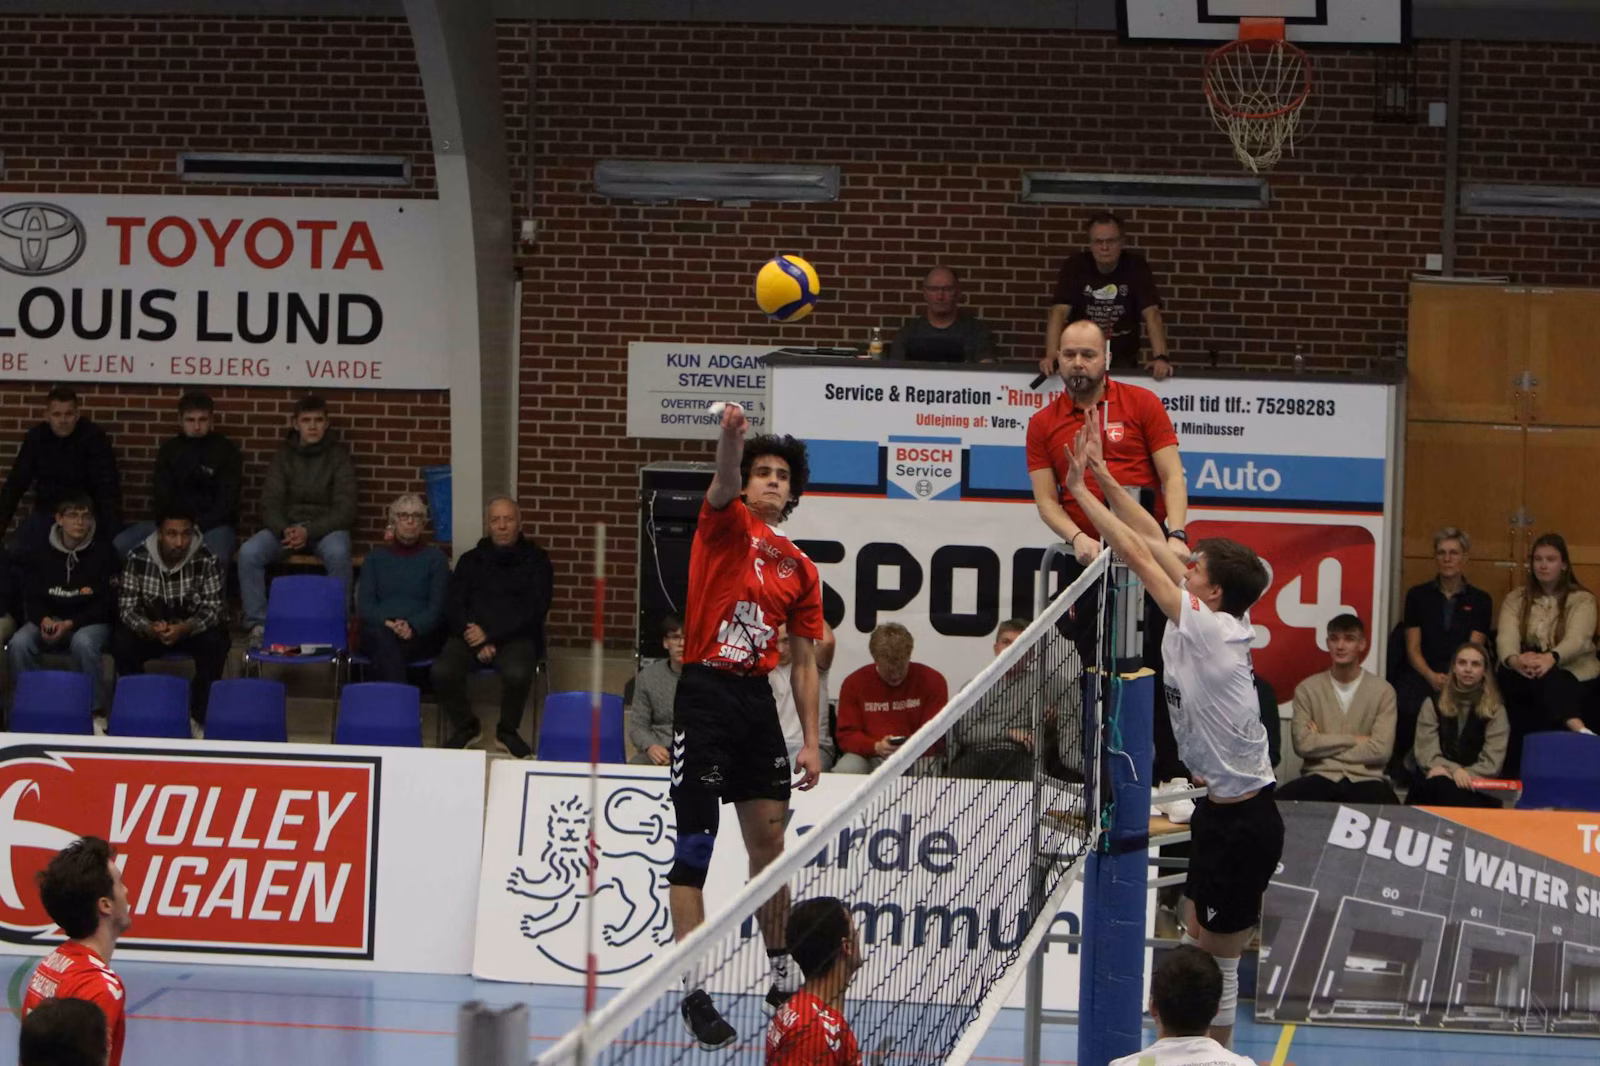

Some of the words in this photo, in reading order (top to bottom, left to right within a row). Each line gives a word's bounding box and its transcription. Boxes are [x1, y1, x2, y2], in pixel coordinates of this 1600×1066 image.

[106, 216, 384, 270] TOYOTA
[196, 290, 383, 345] LUND
[63, 354, 134, 374] VEJEN
[170, 356, 270, 377] ESBJERG
[306, 360, 383, 379] VARDE
[667, 353, 701, 368] KUN
[825, 384, 884, 402] Service
[889, 385, 901, 402] &
[905, 386, 991, 406] Reparation
[1161, 395, 1195, 412] estil
[1200, 396, 1220, 412] tid
[1225, 396, 1250, 414] tlf.:
[1256, 397, 1336, 417] 75298283
[916, 413, 969, 428] Udlejning
[972, 415, 988, 428] af:
[1181, 422, 1245, 436] Minibusser
[896, 448, 952, 463] BOSCH
[896, 464, 952, 478] Service
[1195, 458, 1281, 492] Auto
[718, 645, 750, 662] SHIP
[109, 783, 358, 851] VOLLEY
[1328, 805, 1453, 875] BLUE
[1465, 847, 1569, 909] WATER
[1382, 887, 1399, 900] 60
[1470, 907, 1483, 918] 61
